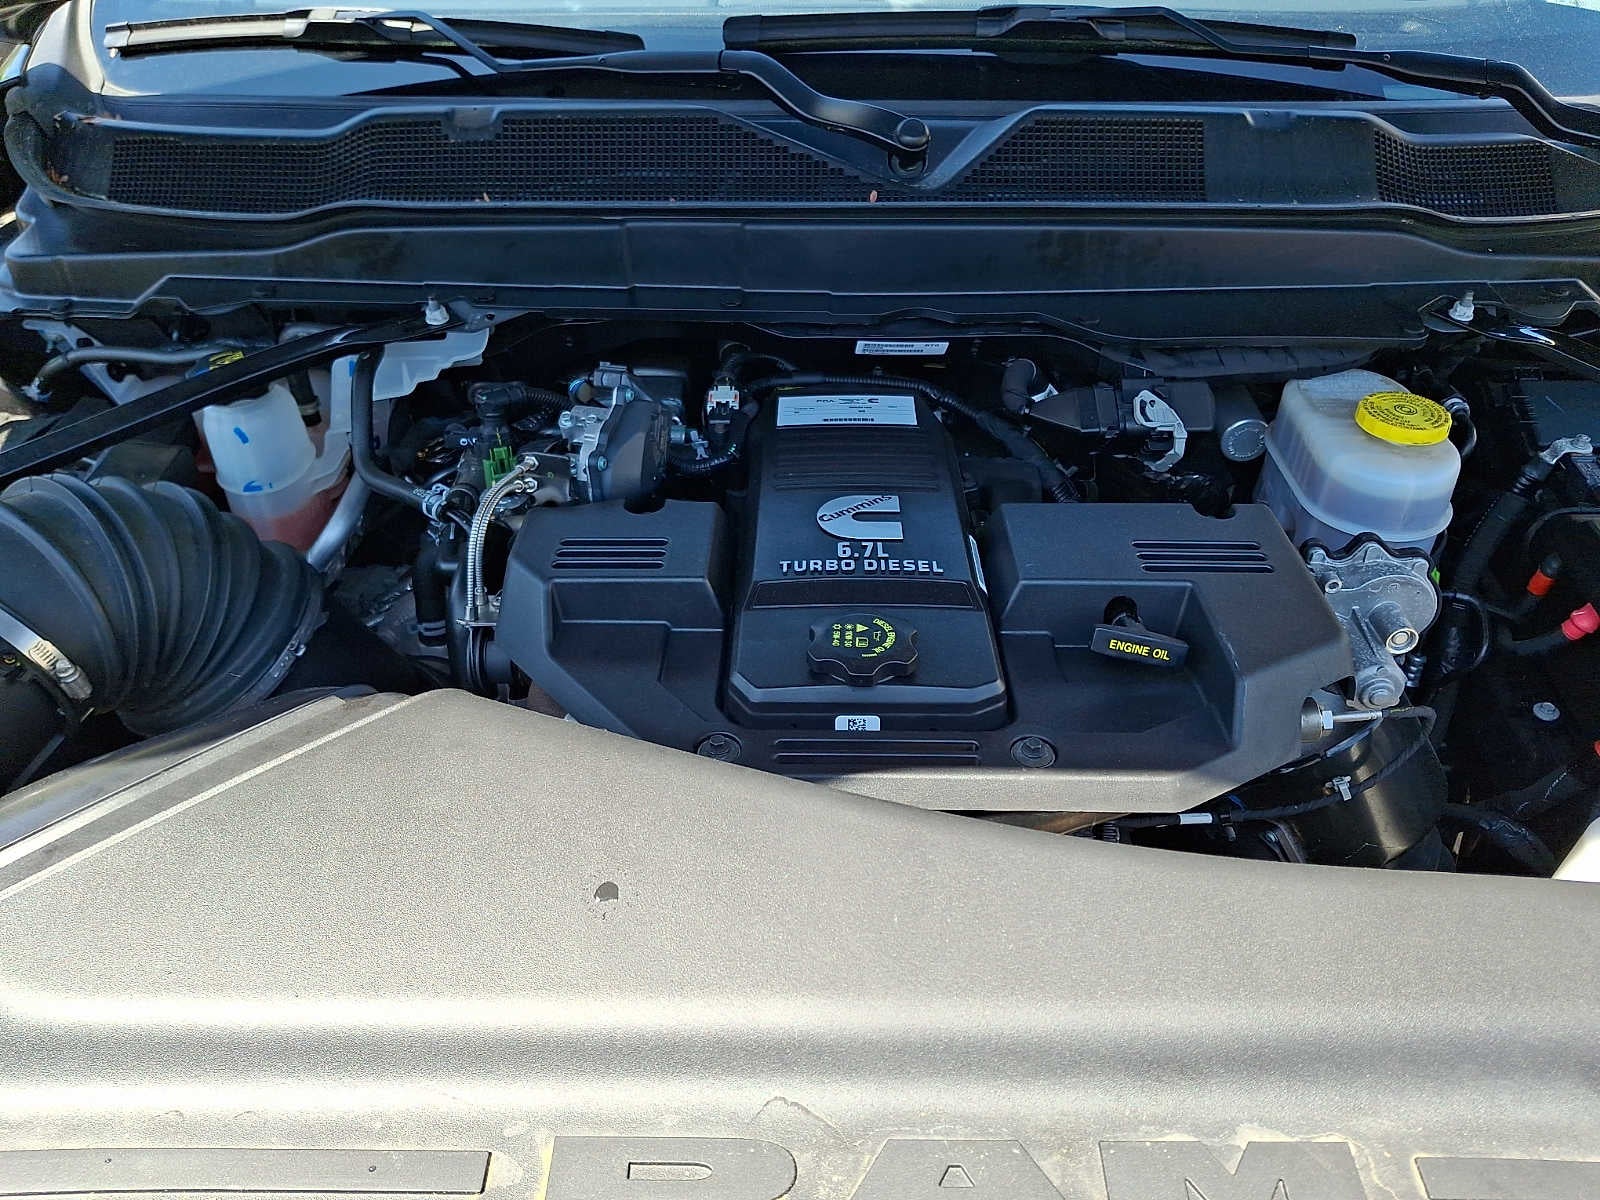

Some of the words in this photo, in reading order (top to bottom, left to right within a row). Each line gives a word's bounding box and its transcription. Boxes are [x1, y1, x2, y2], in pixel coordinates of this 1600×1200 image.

[818, 495, 892, 522] Cummins
[837, 541, 889, 558] 6.7L
[779, 559, 856, 573] TURBO
[864, 559, 944, 574] DIESEL
[1109, 639, 1151, 657] ENGINE
[1152, 648, 1170, 661] OIL
